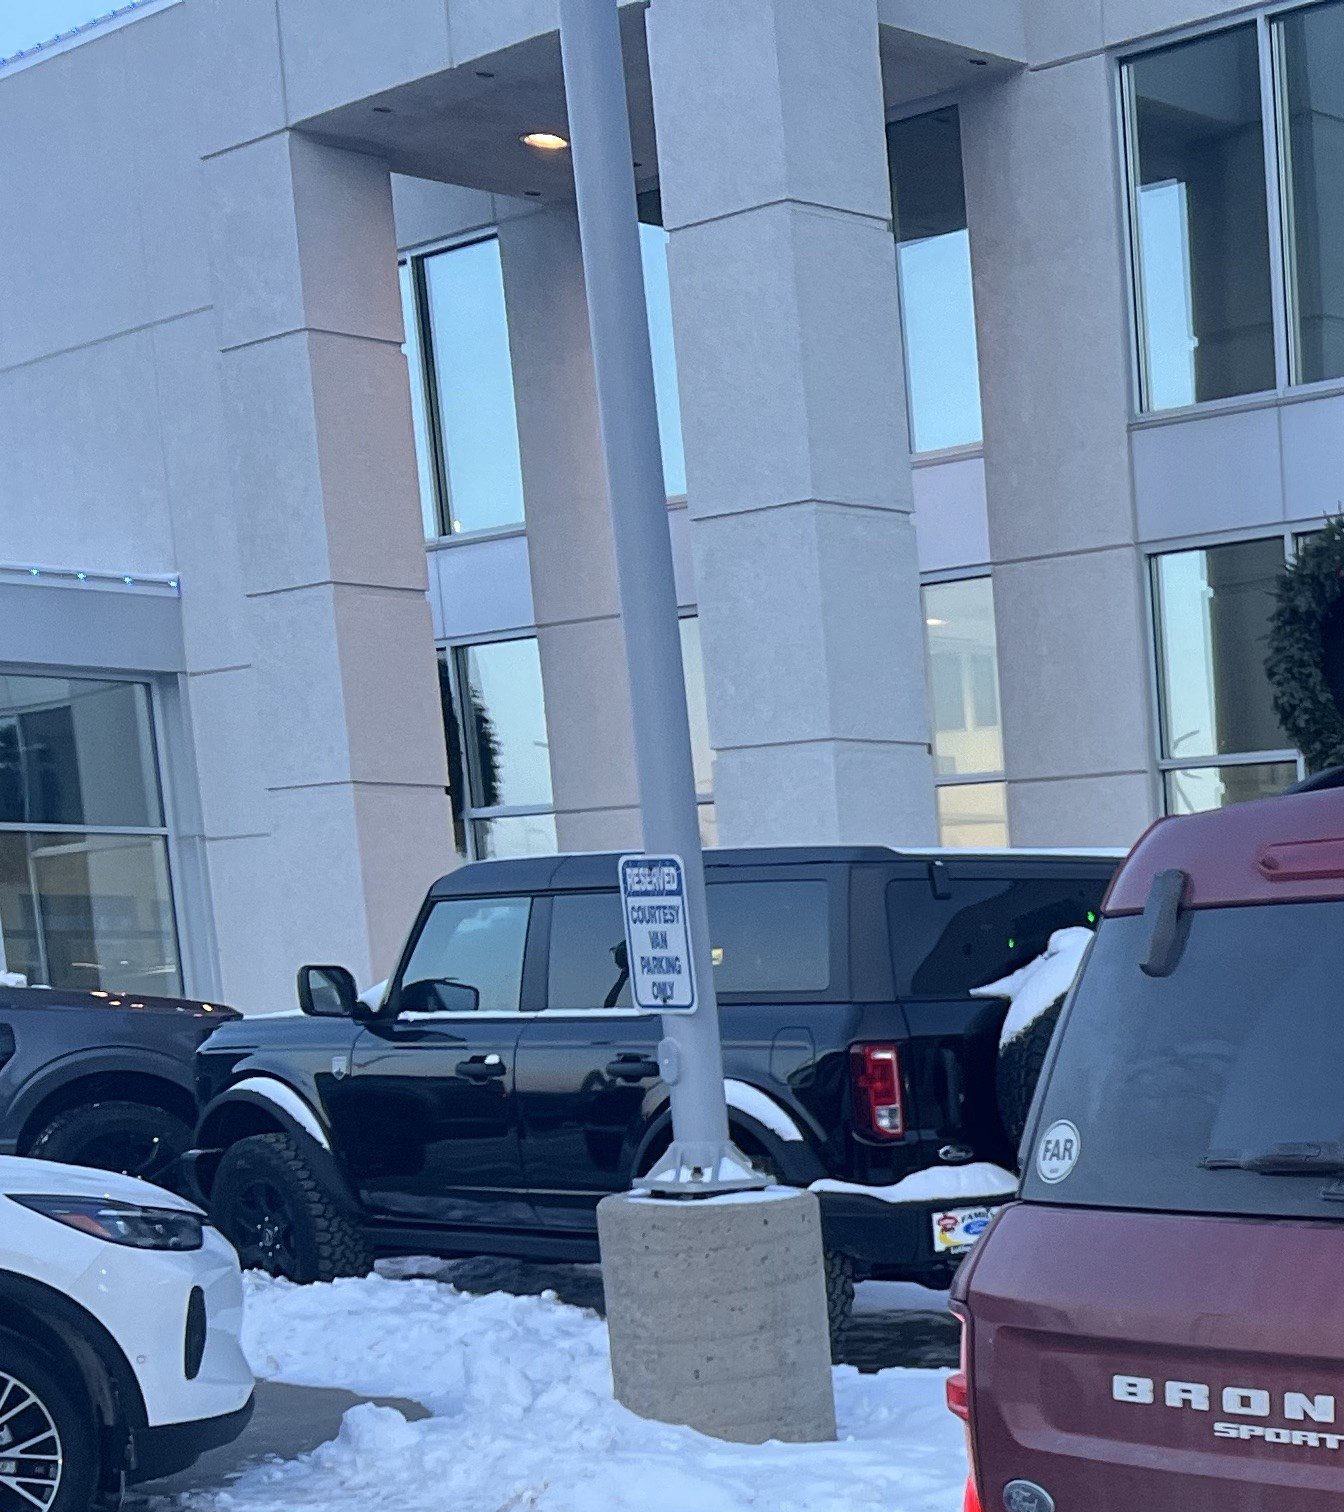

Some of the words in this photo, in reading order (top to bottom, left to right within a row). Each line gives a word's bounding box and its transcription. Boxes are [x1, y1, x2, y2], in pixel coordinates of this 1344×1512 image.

[625, 867, 678, 891] RESERVED
[630, 905, 681, 924] COURTESY
[648, 931, 668, 950] VAN
[640, 956, 682, 975] PARKING
[652, 981, 675, 1000] ONLY
[1042, 1138, 1074, 1161] FAR
